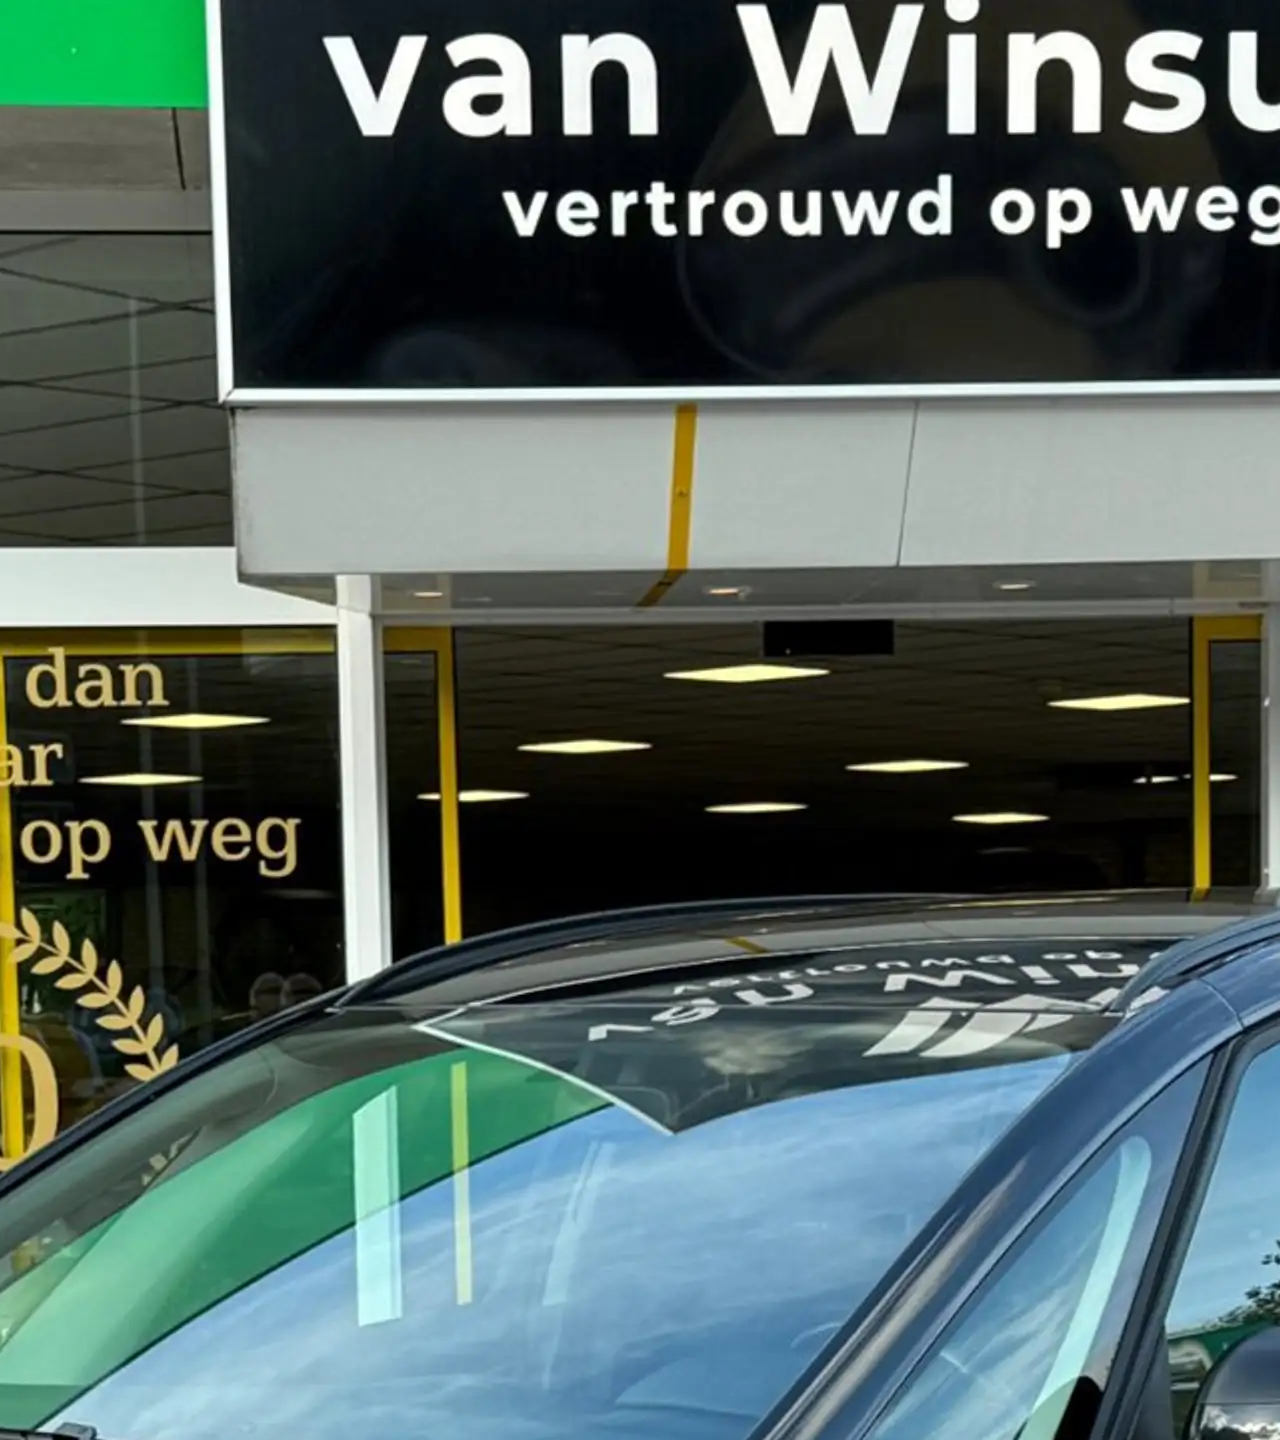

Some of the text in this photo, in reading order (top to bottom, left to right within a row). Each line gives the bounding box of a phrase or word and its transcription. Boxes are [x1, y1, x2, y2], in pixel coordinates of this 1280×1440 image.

[323, 32, 658, 138] van
[503, 174, 952, 237] vertrouwd
[990, 188, 1093, 249] op
[24, 647, 170, 708] dan
[20, 819, 112, 879] op
[139, 817, 300, 877] weg
